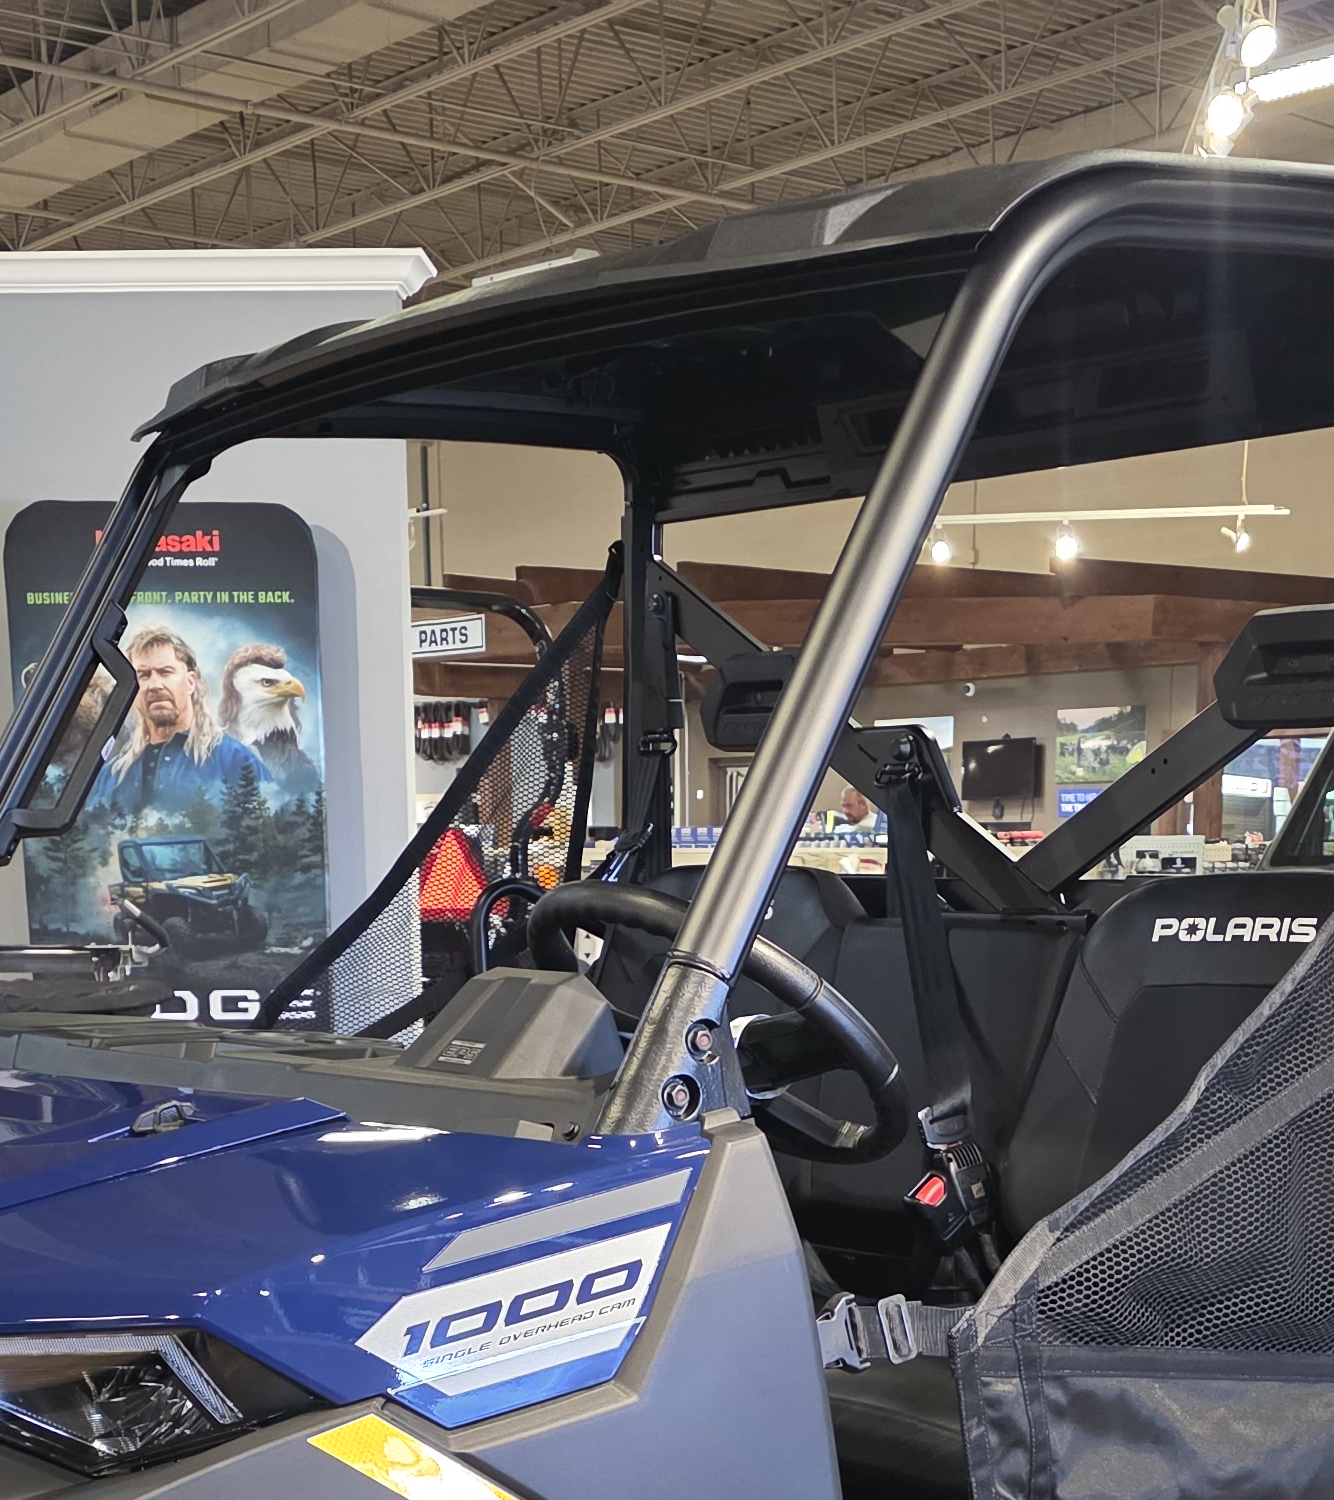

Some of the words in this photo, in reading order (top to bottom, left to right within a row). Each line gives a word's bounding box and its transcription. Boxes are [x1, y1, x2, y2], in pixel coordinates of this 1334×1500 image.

[95, 530, 220, 552] asaki
[148, 557, 164, 567] od
[165, 557, 195, 567] Times
[27, 592, 73, 605] BUSINE
[175, 592, 213, 604] PARTY
[217, 591, 230, 603] IN
[232, 591, 255, 603] THE
[258, 591, 295, 603] BACK.
[419, 626, 468, 648] PARTS
[1152, 917, 1318, 943] POLARIS
[402, 1259, 644, 1357] 1000
[422, 1341, 492, 1369] SINGLE
[498, 1310, 595, 1347] OVERHEAD
[598, 1297, 637, 1317] CAM
